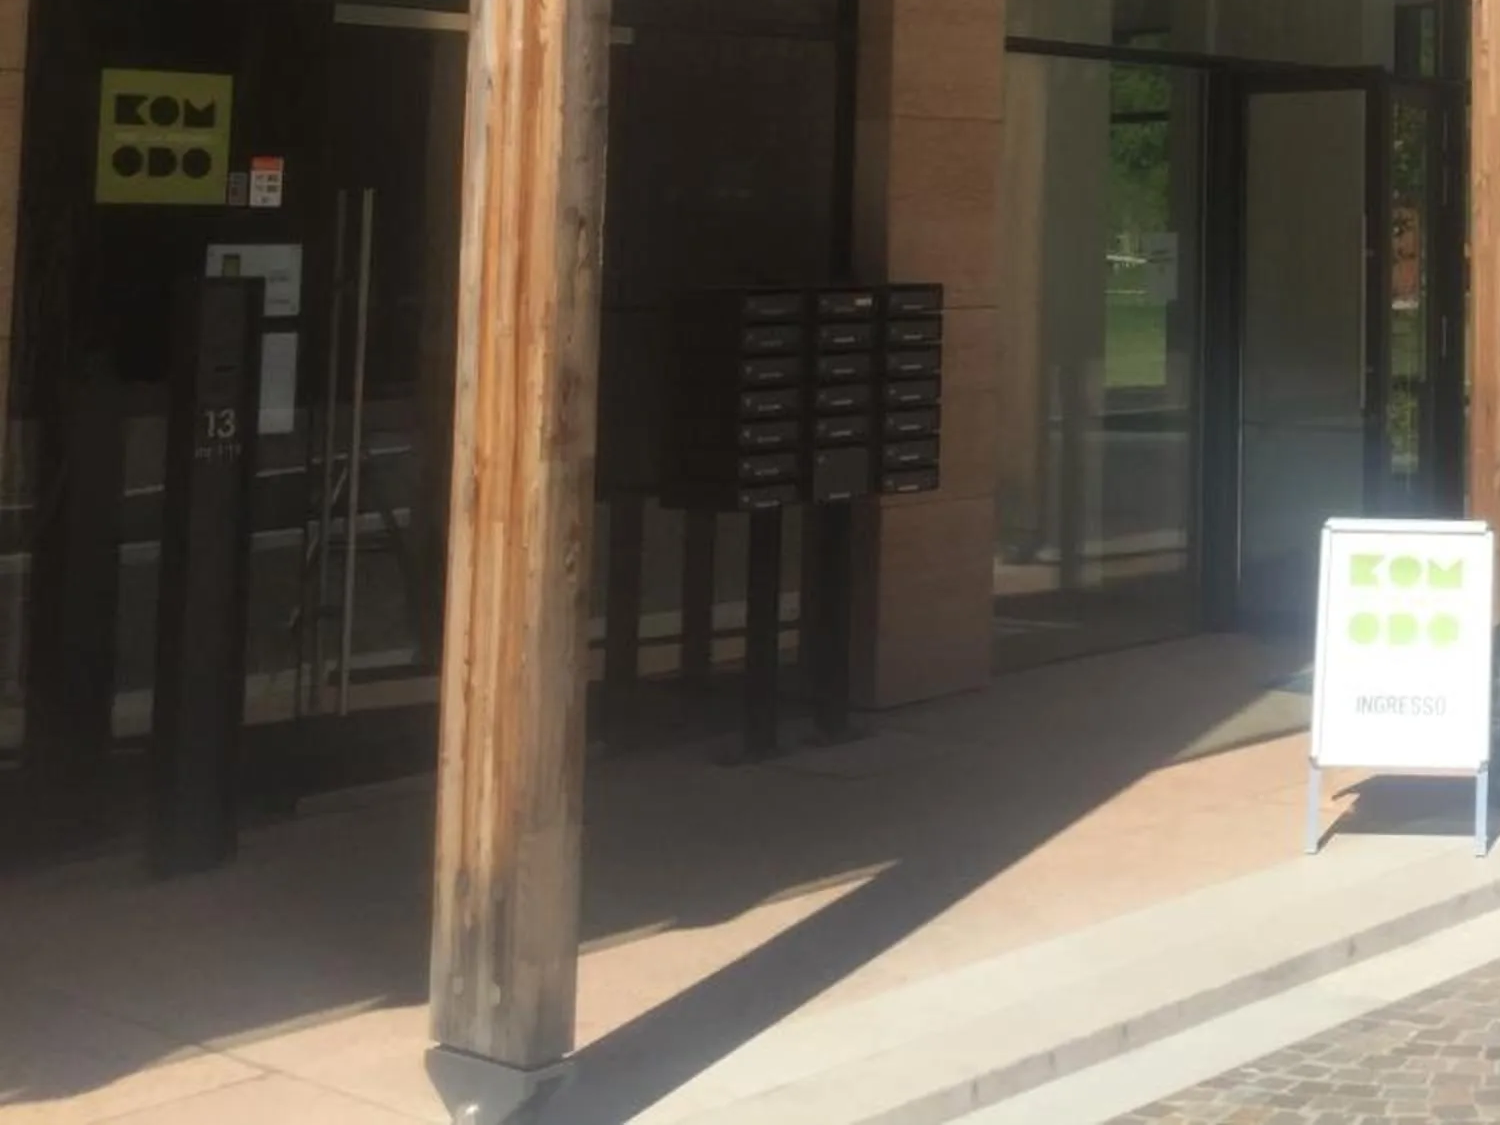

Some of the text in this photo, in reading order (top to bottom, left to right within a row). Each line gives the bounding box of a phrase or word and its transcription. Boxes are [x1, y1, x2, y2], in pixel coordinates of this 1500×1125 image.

[114, 94, 215, 129] KOM
[112, 145, 212, 179] ODO
[204, 408, 237, 438] 13
[1349, 553, 1464, 589] KOM
[1348, 611, 1460, 647] ODO
[1356, 695, 1448, 716] INGRESSO
